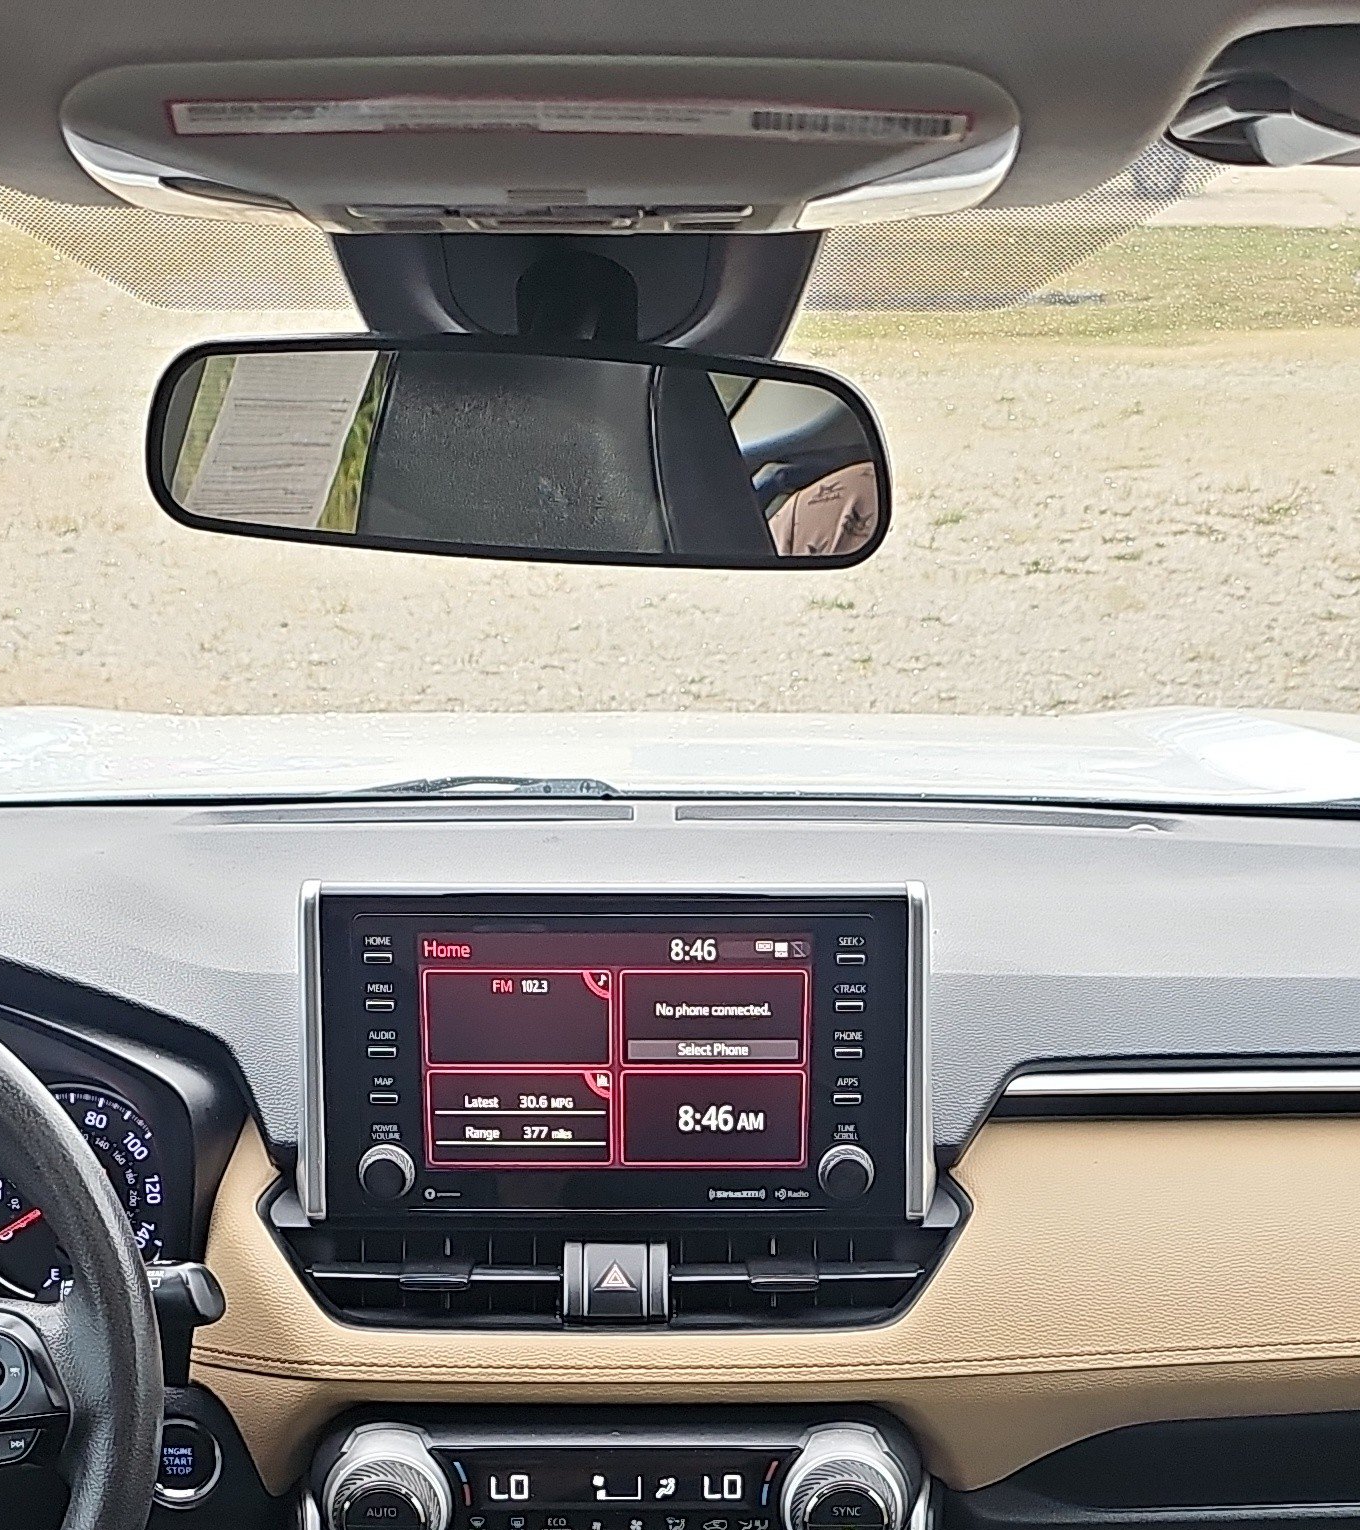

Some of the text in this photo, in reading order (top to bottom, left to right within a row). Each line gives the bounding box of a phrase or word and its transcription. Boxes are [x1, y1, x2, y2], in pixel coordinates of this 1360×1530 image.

[364, 936, 391, 946] HOME
[423, 940, 471, 958] Home
[668, 939, 717, 961] 8:46
[367, 984, 393, 993] MENU
[492, 980, 548, 993] FM 102.3
[655, 1002, 771, 1018] No phone connected.
[368, 1031, 396, 1040] AUDIO
[834, 1031, 863, 1040] PHONE
[677, 1043, 749, 1056] Select Phone
[374, 1077, 394, 1087] MAP
[837, 1077, 859, 1087] APPS
[464, 1095, 574, 1109] Latest 30.6 MPG
[84, 1111, 107, 1129] 80
[678, 1105, 764, 1131] 8:46 AM
[465, 1127, 500, 1141] Range
[523, 1126, 549, 1139] 377
[95, 1137, 110, 1150] 140
[122, 1132, 148, 1160] 100
[112, 1151, 125, 1165] 160
[125, 1169, 136, 1185] 180
[145, 1175, 161, 1204] 120
[134, 1222, 155, 1249] 140
[51, 1268, 60, 1281] E
[163, 1447, 192, 1455] ENGINE
[163, 1457, 193, 1465] START
[166, 1466, 192, 1475] STOP
[366, 1507, 397, 1518] AUTO
[832, 1506, 862, 1517] SYNC
[547, 1516, 567, 1526] ECO
